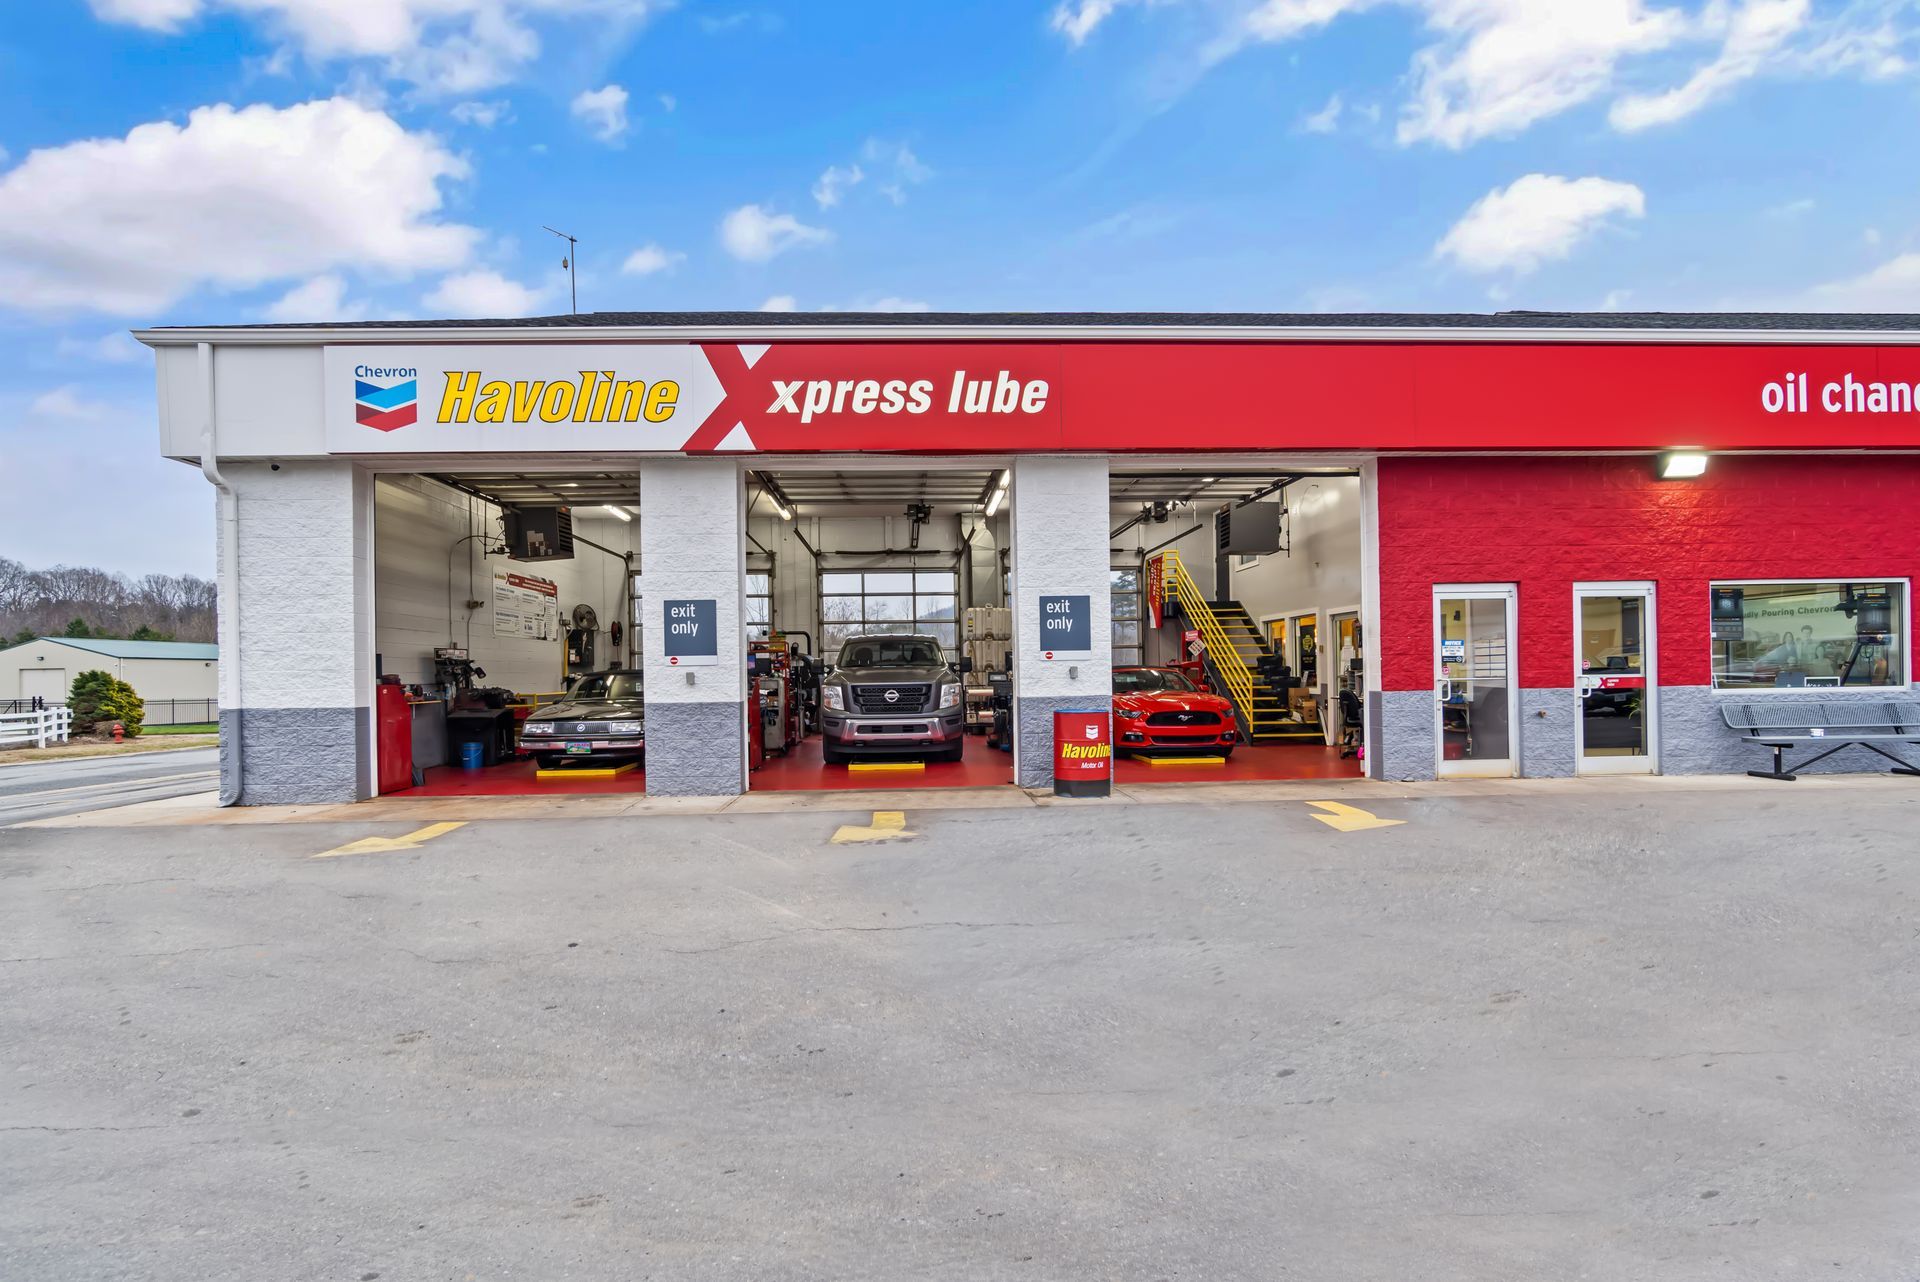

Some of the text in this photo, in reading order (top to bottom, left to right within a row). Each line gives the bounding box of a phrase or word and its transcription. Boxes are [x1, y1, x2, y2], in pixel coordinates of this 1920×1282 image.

[354, 365, 418, 378] Chevron
[436, 370, 681, 424] Havoline
[765, 379, 934, 424] xpress
[947, 370, 1050, 414] lube
[1761, 372, 1808, 413] oil
[671, 603, 696, 618] exit
[1046, 599, 1071, 613] exit
[1743, 605, 1835, 619] udly Pouring Chevron
[671, 620, 699, 637] only
[1046, 616, 1073, 632] only
[1061, 742, 1110, 759] Havolin
